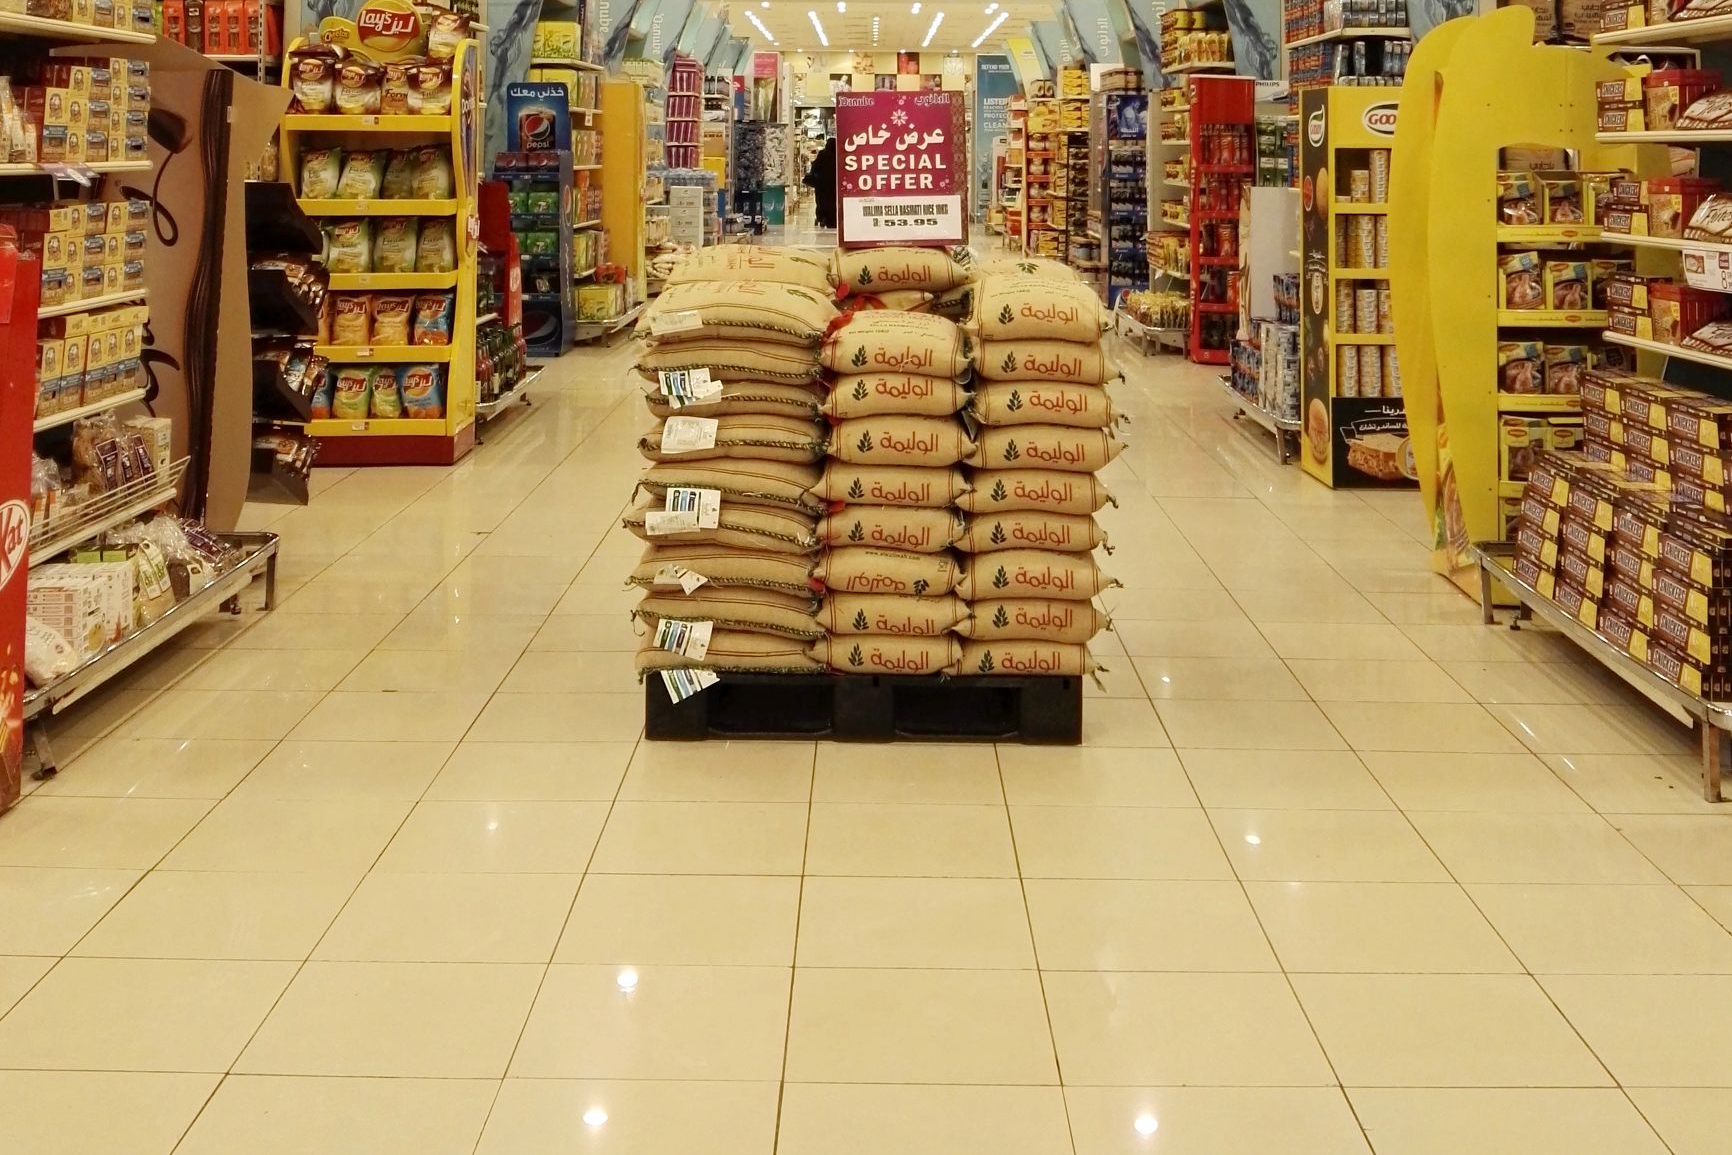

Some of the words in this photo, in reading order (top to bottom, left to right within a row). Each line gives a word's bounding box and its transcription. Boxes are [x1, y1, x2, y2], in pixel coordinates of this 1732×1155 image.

[360, 10, 393, 31] Lay's
[382, 16, 415, 34] ليز
[510, 87, 536, 98] معك
[537, 86, 564, 101] خذني
[1369, 114, 1396, 125] GOO
[526, 140, 550, 151] pepsi
[844, 123, 891, 152] خاص
[896, 124, 944, 150] عرض
[844, 154, 946, 171] SPECIAL
[858, 174, 934, 190] OFFER
[884, 218, 938, 226] 53.95
[878, 264, 931, 283] الوليمة
[1021, 302, 1079, 325] الوليمة
[874, 346, 932, 369] الوليمة
[1024, 353, 1082, 377] الوليمة
[875, 378, 934, 399] الوليمة
[1029, 390, 1088, 415] الوليمة
[880, 431, 938, 454] الوليمة
[1026, 441, 1085, 463] الوليمة
[871, 482, 930, 502] الوليمة
[1014, 480, 1072, 503] الوليمة
[872, 524, 930, 546] الوليمة
[1012, 522, 1070, 544] الوليمة
[1665, 542, 1690, 565] SNICKERS
[1015, 566, 1074, 592] الوليمة
[1660, 579, 1685, 603] SNICKERS
[1016, 604, 1072, 631] الوليمة
[1661, 615, 1687, 640] SNICKERS
[1605, 617, 1630, 641] SNICKERS
[870, 647, 929, 672] الوليمة
[1001, 652, 1061, 673] الوليمة
[1653, 649, 1680, 675] SNICKERS
